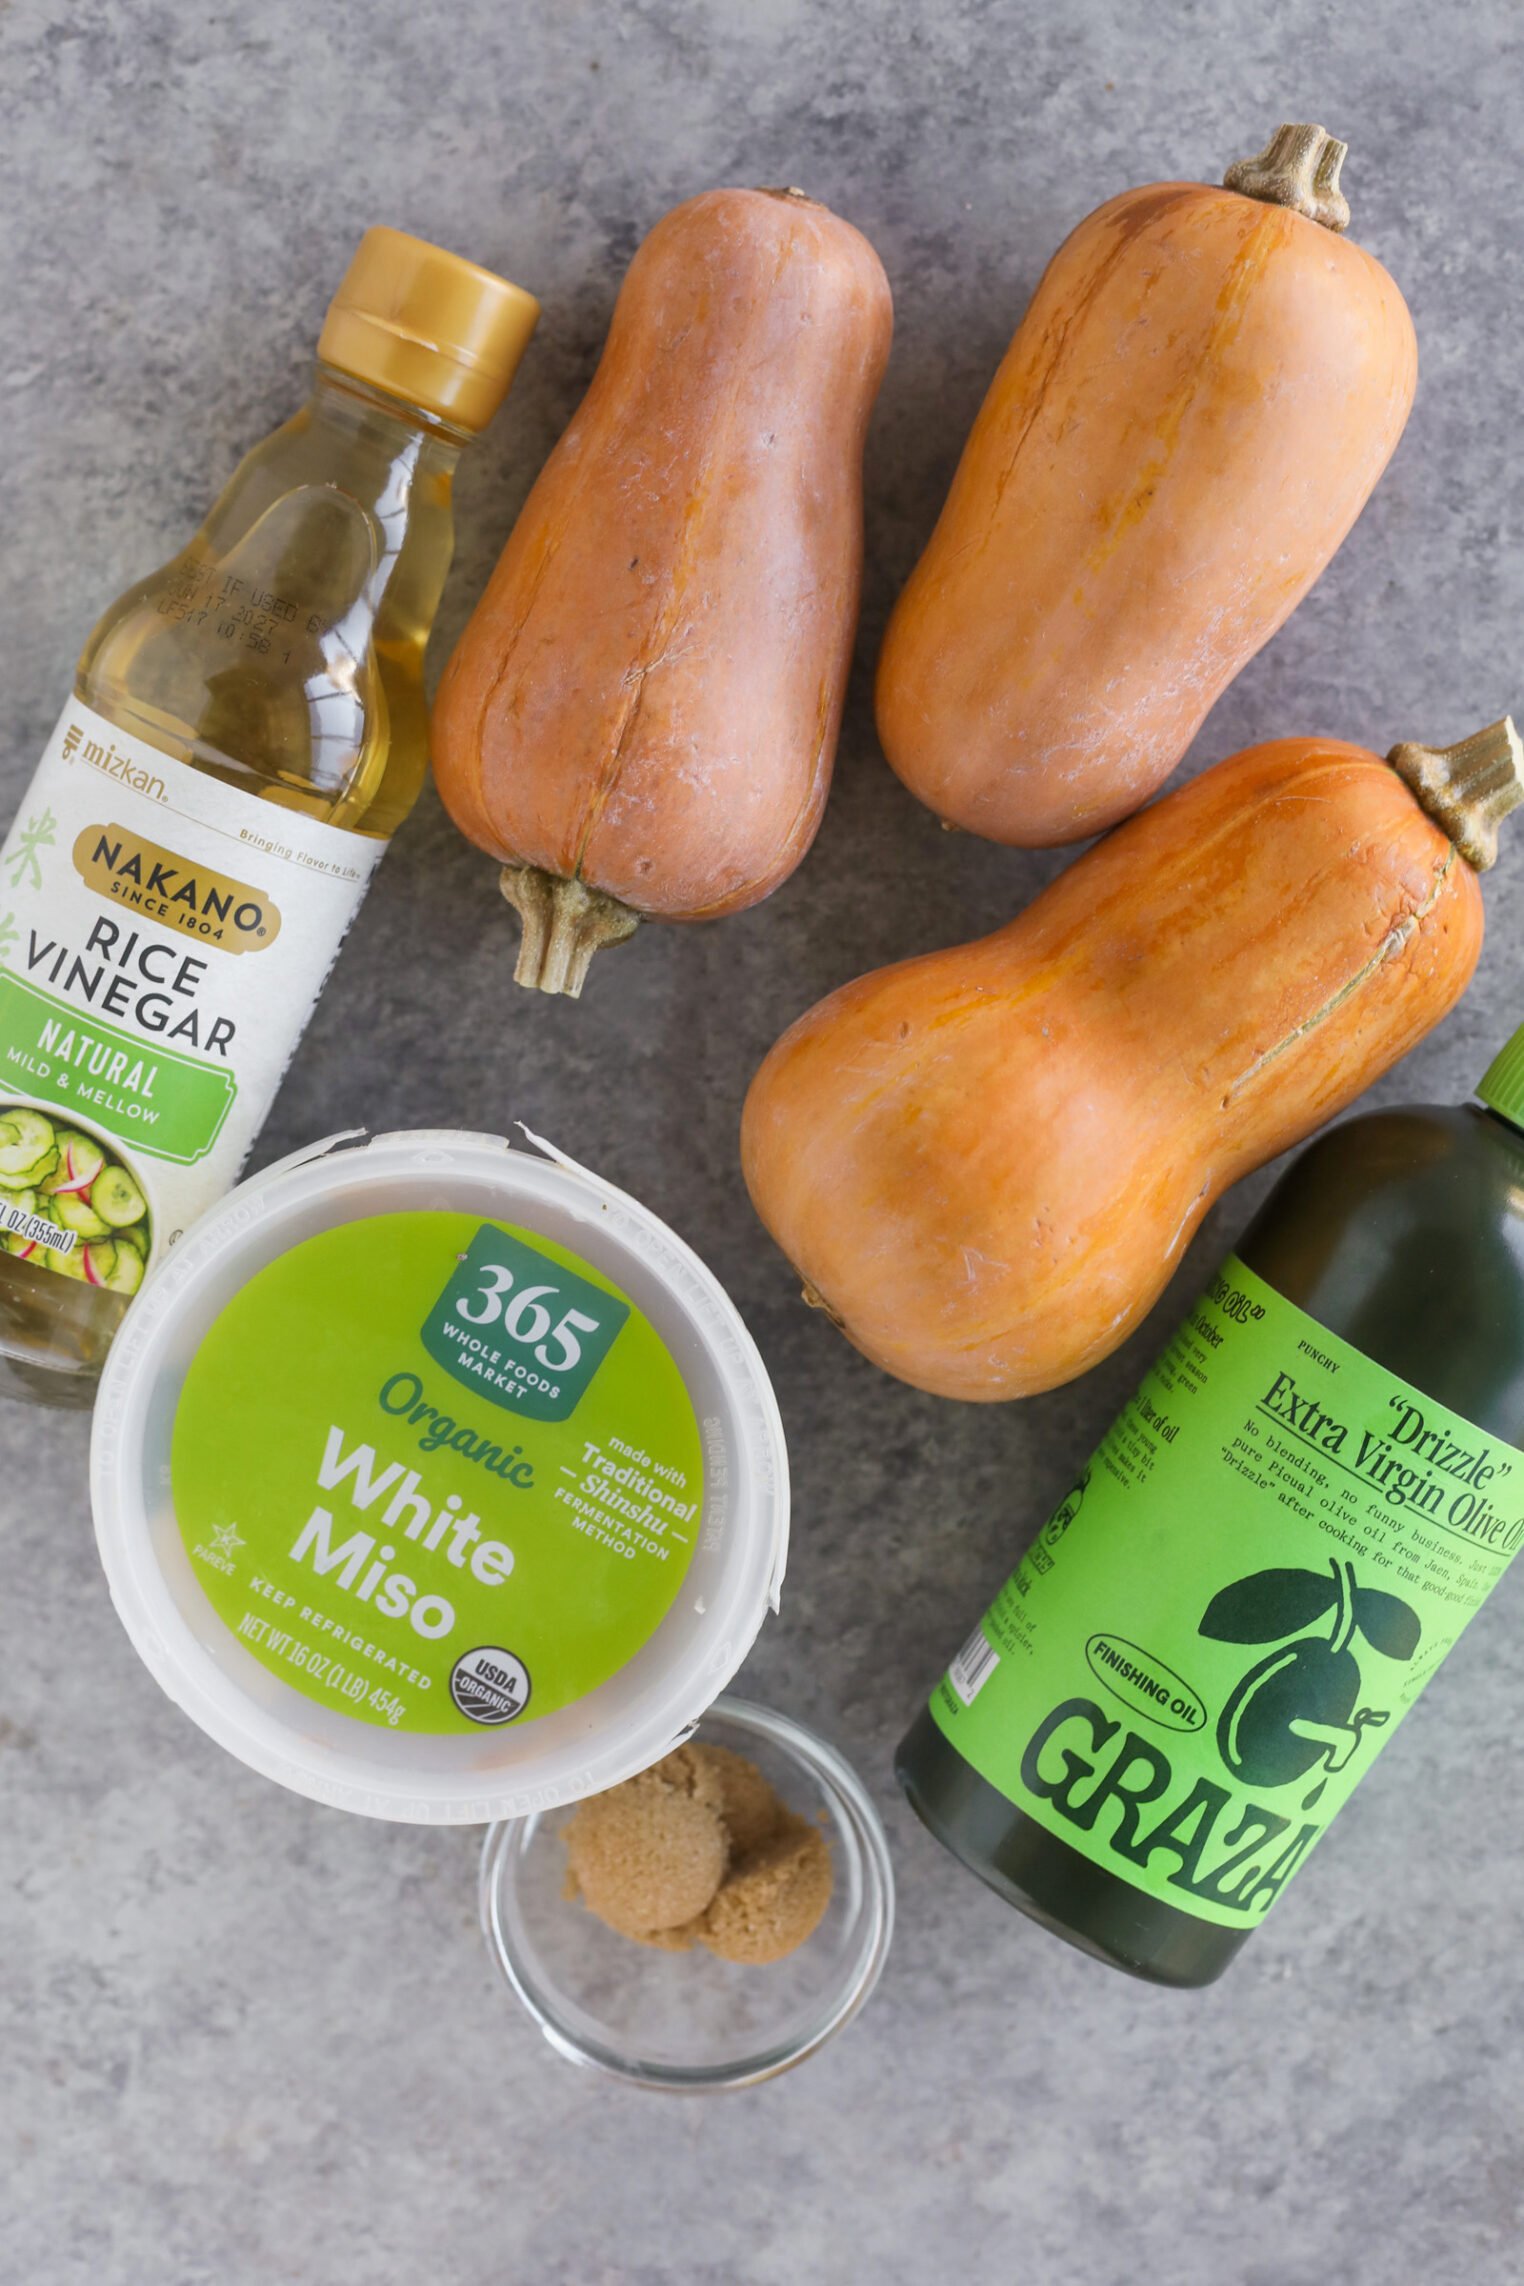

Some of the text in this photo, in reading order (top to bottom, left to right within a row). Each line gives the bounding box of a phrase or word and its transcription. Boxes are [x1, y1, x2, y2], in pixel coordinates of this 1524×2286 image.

[222, 576, 244, 596] IF
[251, 587, 299, 623] USED
[232, 605, 279, 634] 2027
[82, 739, 165, 800] mizkan
[91, 834, 263, 931] NAKANO
[239, 828, 292, 859] Bringing
[296, 851, 329, 873] Flavor
[331, 863, 341, 874] to
[111, 881, 225, 941] SINCE 1804
[27, 929, 236, 1057] VINEGAR
[85, 915, 208, 998] RICE
[6, 1046, 161, 1126] MILD & MELLOW
[37, 1018, 160, 1098] NATURAL
[456, 1264, 600, 1372] 365
[1297, 1339, 1341, 1375] PUNCHY
[442, 1322, 561, 1399] WHOLE FOODS
[457, 1352, 528, 1400] MARKET
[379, 1371, 534, 1489] Organic
[608, 1436, 687, 1489] made with
[1152, 1415, 1168, 1432] of
[1161, 1425, 1180, 1444] oil
[1259, 1370, 1349, 1455] Extra
[1353, 1430, 1447, 1506] Virgin
[1447, 1492, 1506, 1548] Olive
[316, 1424, 516, 1587] White
[579, 1474, 669, 1537] Shinshu
[582, 1442, 698, 1523] Traditional
[1231, 1436, 1264, 1463] pure
[1267, 1461, 1315, 1498] Picual
[1319, 1496, 1358, 1527] olive
[1362, 1522, 1387, 1544] oil
[1392, 1540, 1421, 1564] from
[1243, 1419, 1260, 1438] No
[1265, 1429, 1330, 1490] blending,
[1340, 1488, 1359, 1505] no
[1364, 1502, 1406, 1535] funny
[1411, 1529, 1463, 1565] business.
[192, 1544, 236, 1576] PAREVE
[553, 1487, 670, 1561] FERMENTATION
[571, 1517, 636, 1560] METHOD
[1277, 1491, 1316, 1522] after
[1318, 1519, 1369, 1559] cooking
[1371, 1549, 1394, 1569] for
[1396, 1565, 1420, 1584] that
[288, 1505, 456, 1640] Miso
[237, 1611, 270, 1643] NET
[268, 1627, 293, 1656] WT
[287, 1640, 307, 1666] 16
[306, 1652, 331, 1679] OZ
[340, 1672, 370, 1704] LB)
[368, 1686, 407, 1727] 454g
[249, 1576, 433, 1691] KEEP REFRIGERATED
[459, 1676, 511, 1713] ORGANIC
[475, 1658, 517, 1694] USDA
[1092, 1641, 1198, 1726] FINISHING OIL
[1019, 1697, 1320, 1913] GRAZA
